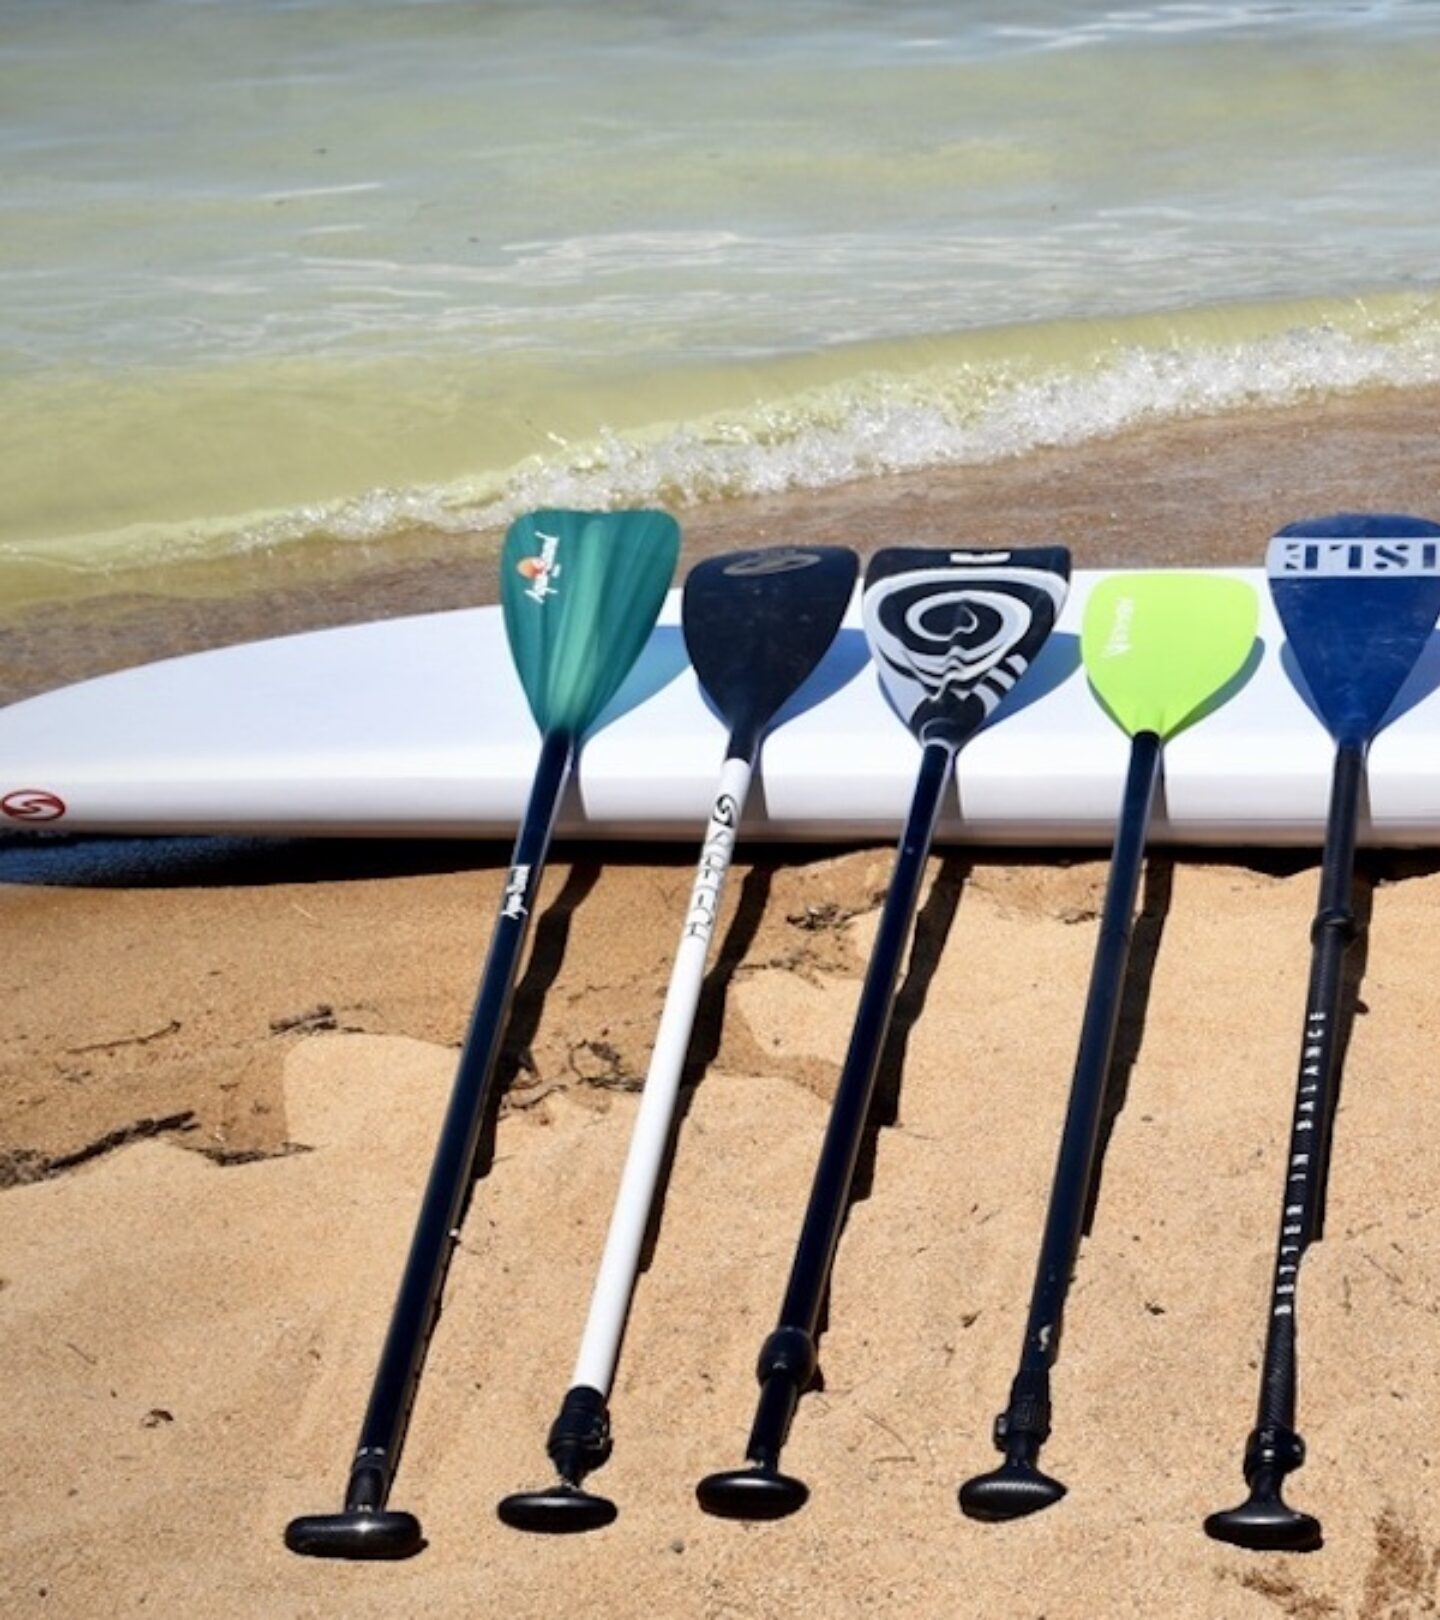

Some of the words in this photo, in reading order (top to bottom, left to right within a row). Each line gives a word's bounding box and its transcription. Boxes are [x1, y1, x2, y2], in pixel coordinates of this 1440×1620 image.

[1285, 543, 1436, 571] ISLE
[1296, 1012, 1326, 1131] BALANCE
[1290, 1154, 1309, 1181] IN
[1274, 1204, 1304, 1316] BETTER
